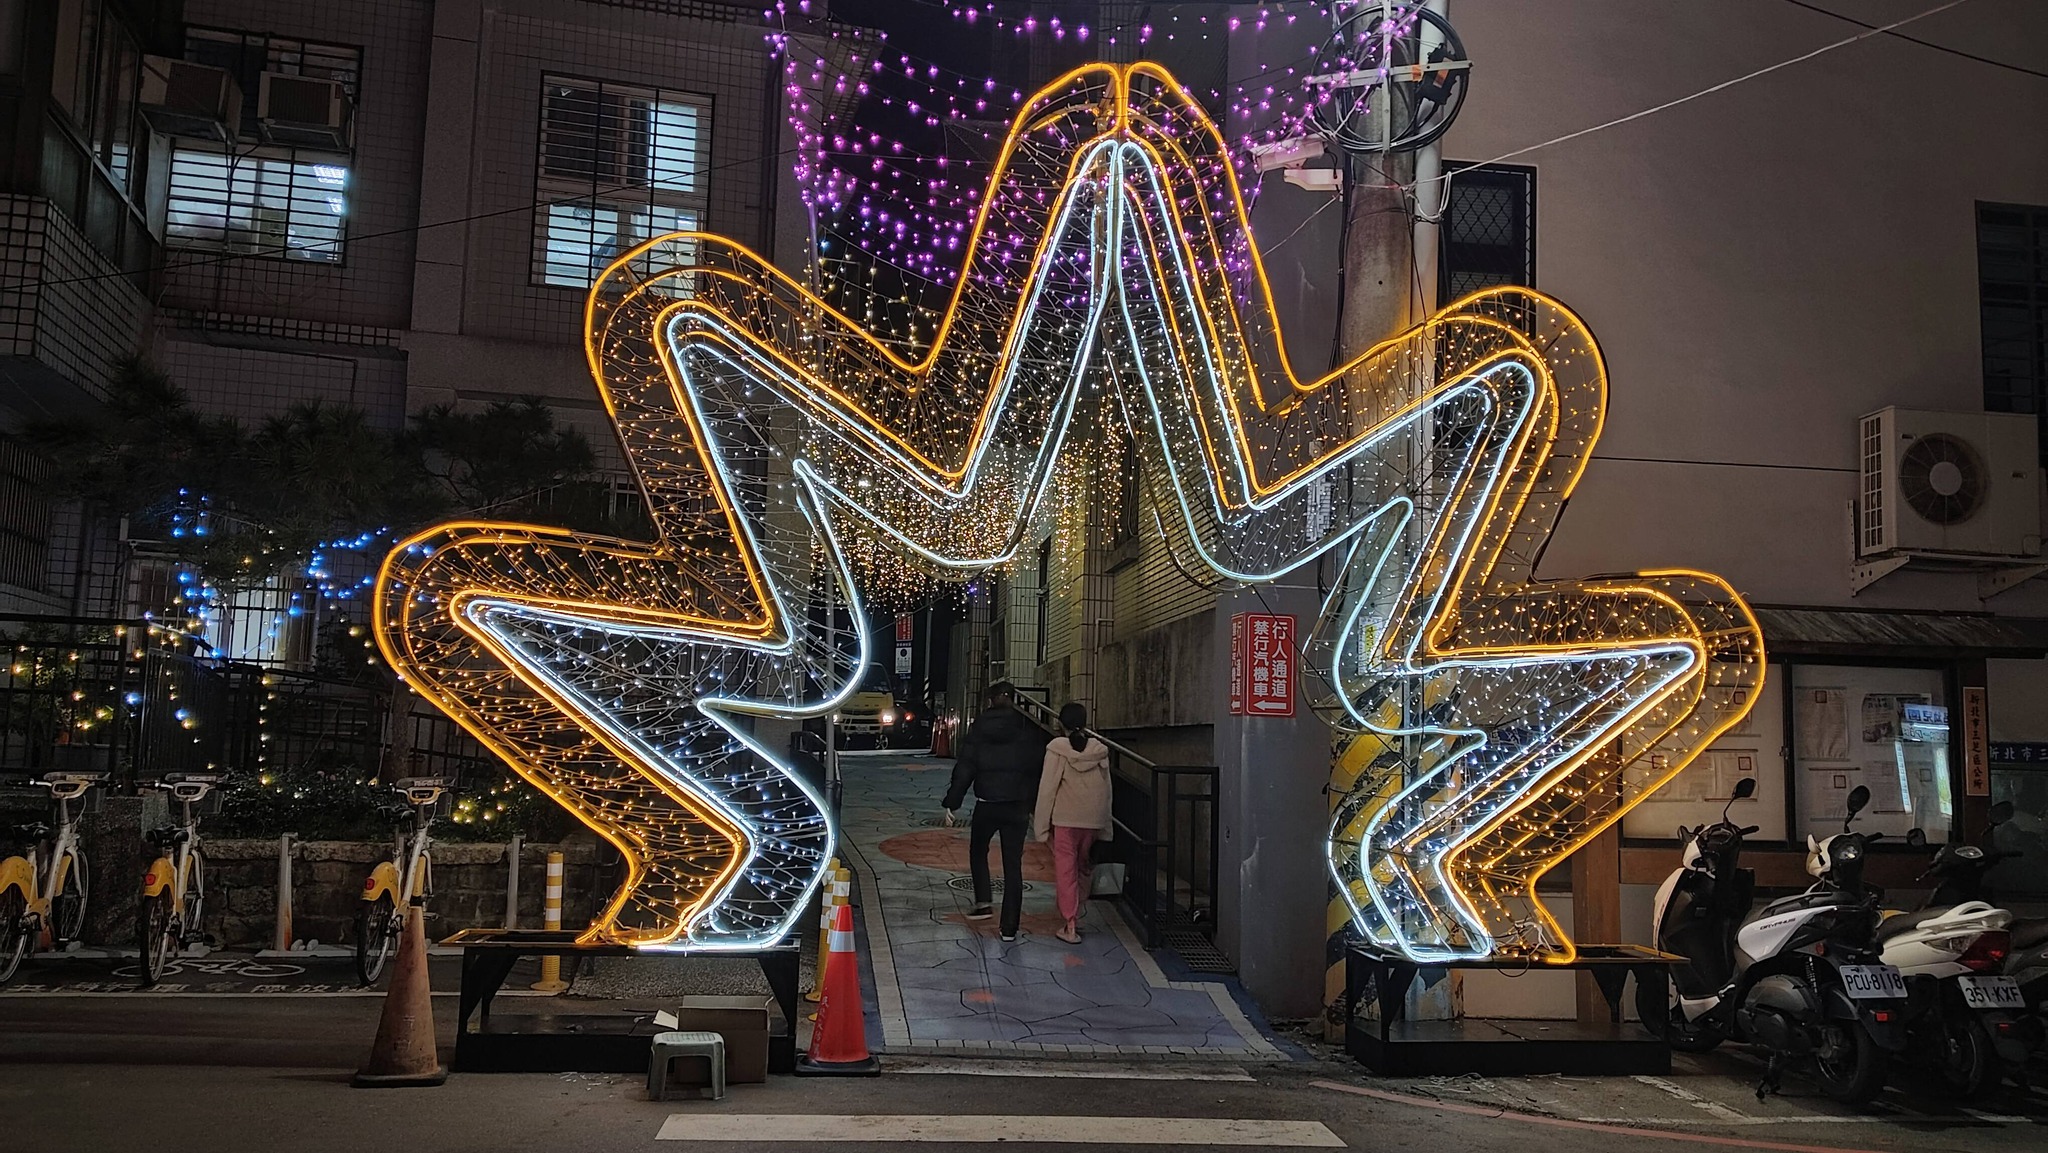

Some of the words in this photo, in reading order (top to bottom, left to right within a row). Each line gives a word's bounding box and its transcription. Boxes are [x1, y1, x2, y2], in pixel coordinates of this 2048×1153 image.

[1252, 620, 1269, 697] 禁行汽機車
[1271, 621, 1288, 698] 行人通道
[1844, 972, 1903, 992] PCU-8118
[1965, 986, 2020, 1003] 351-KXF
